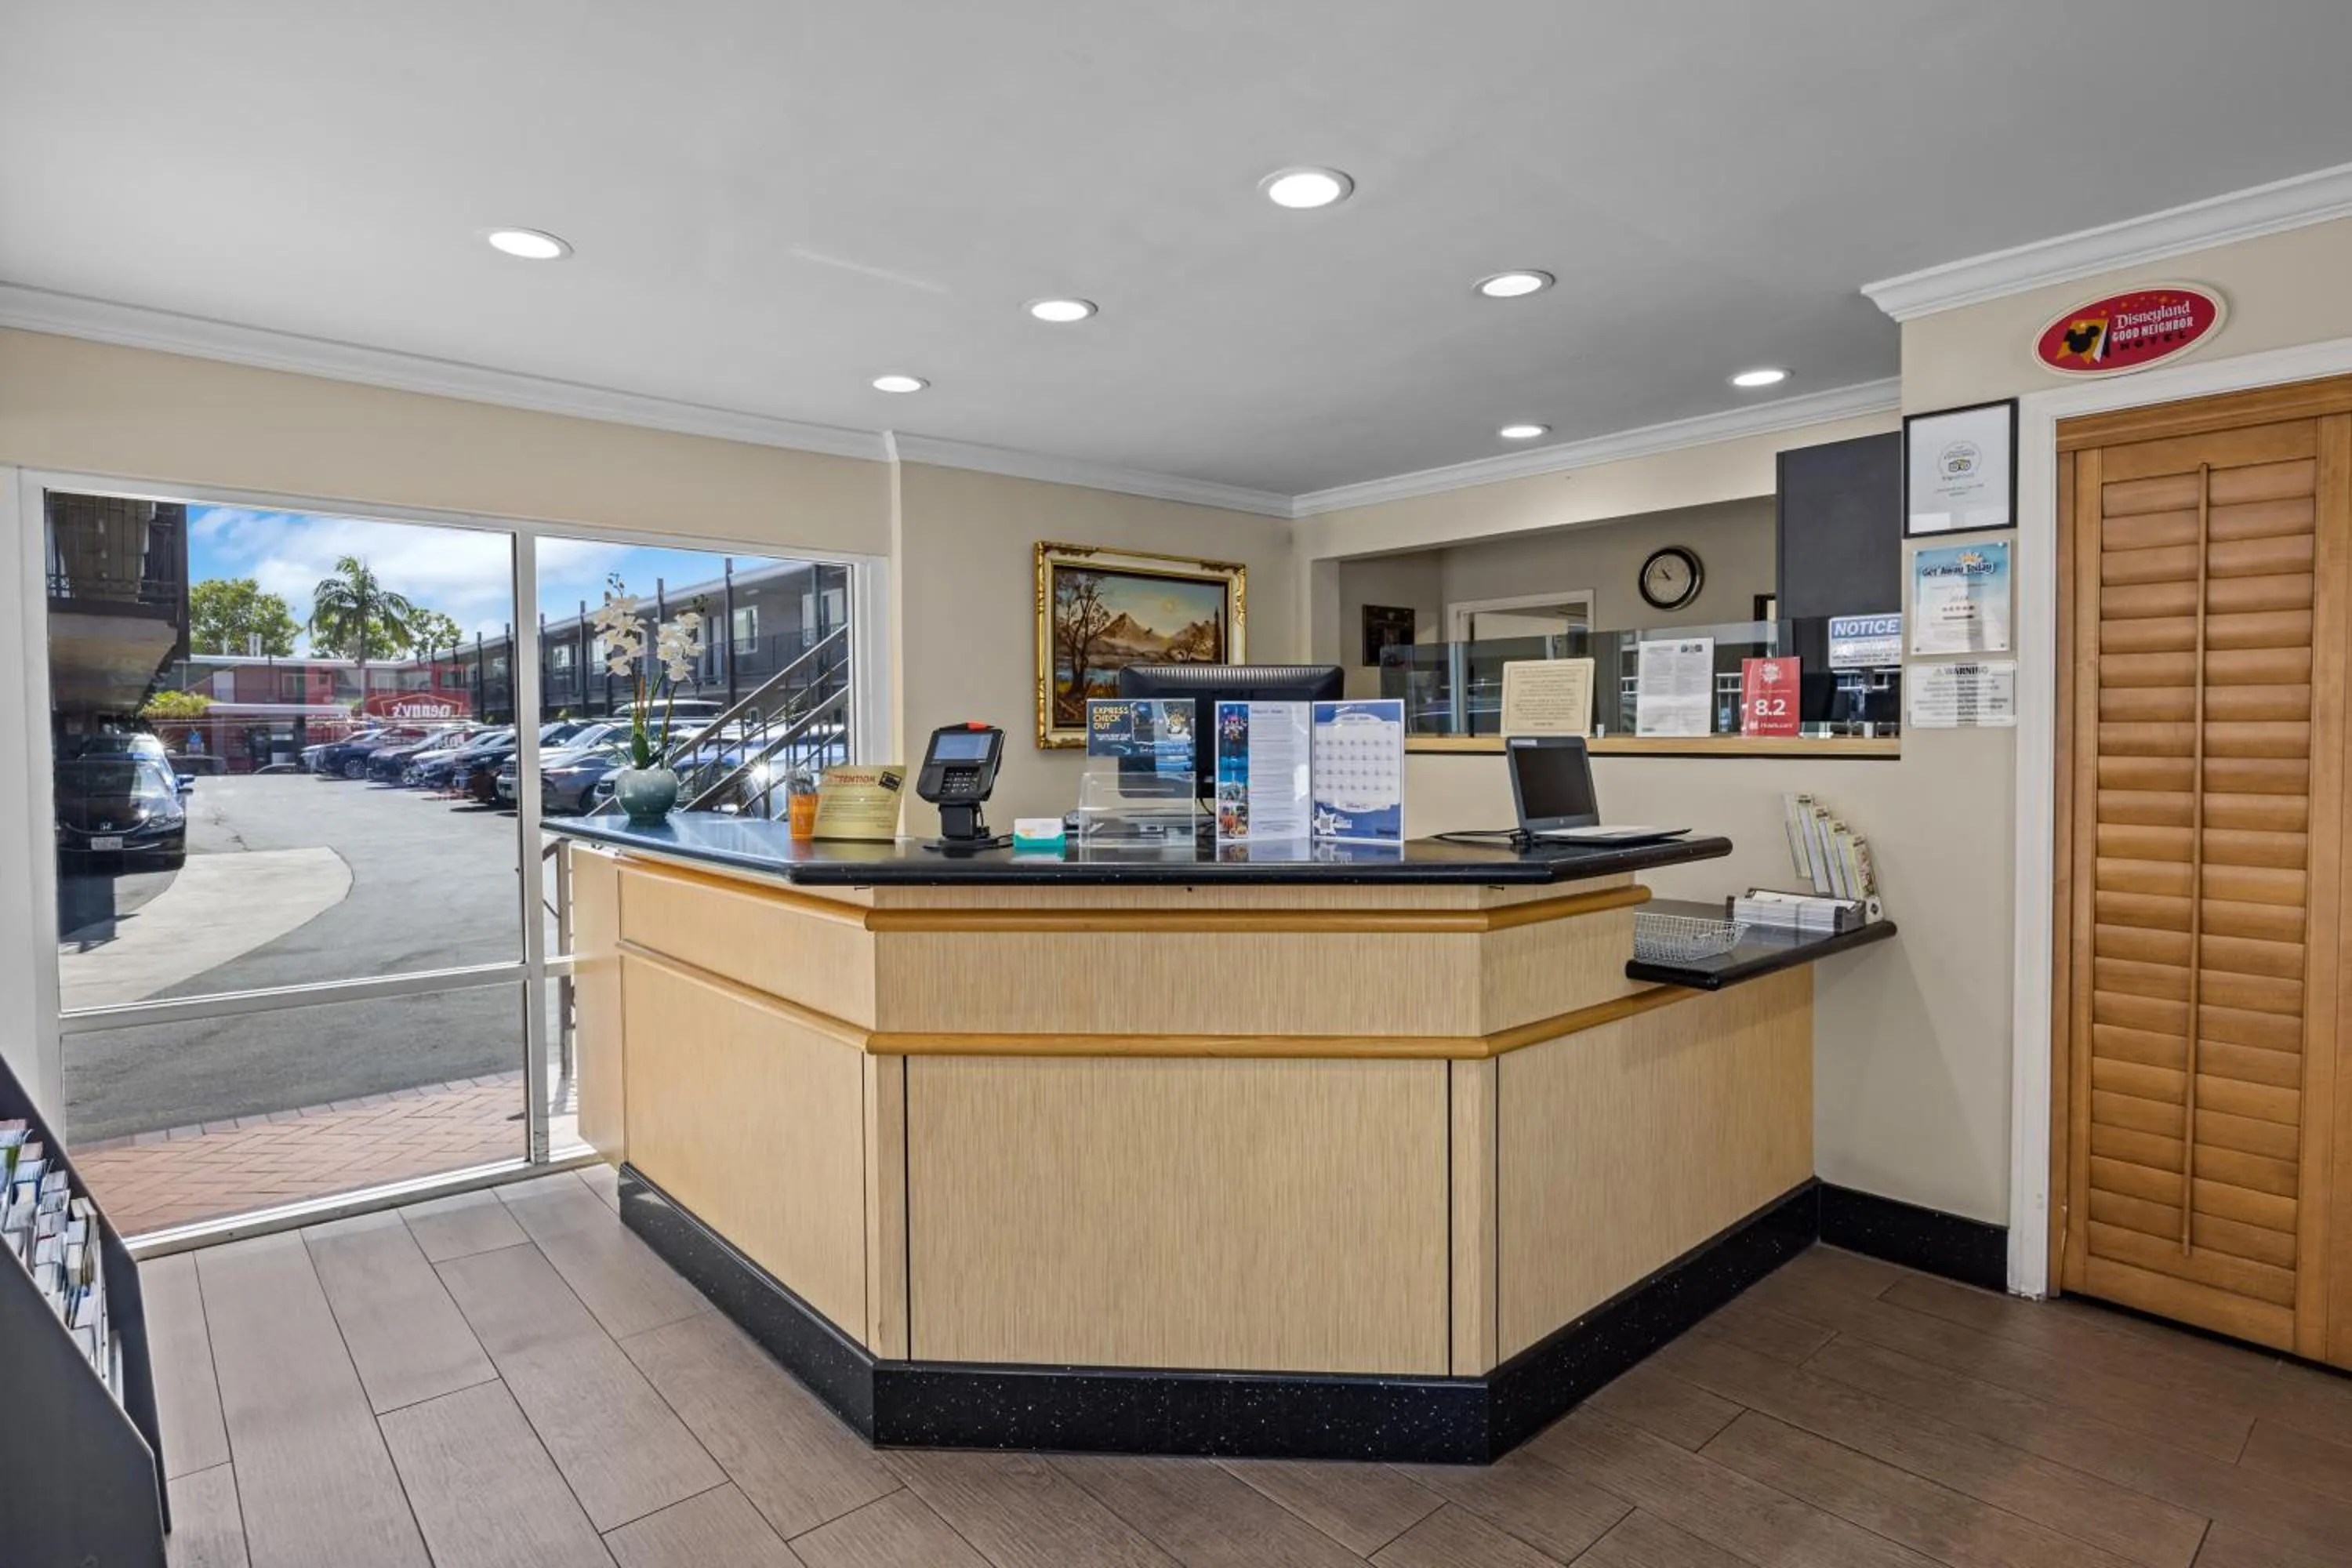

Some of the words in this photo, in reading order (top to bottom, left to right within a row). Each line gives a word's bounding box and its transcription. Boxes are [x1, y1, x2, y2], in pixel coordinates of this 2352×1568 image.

[2115, 300, 2190, 328] Disneyland
[2112, 328, 2140, 342] GOOD
[2141, 317, 2194, 336] NEIGHBOR
[2119, 332, 2187, 350] HOTEL
[1834, 619, 1900, 637] NOTICE
[1944, 666, 1989, 675] WARNING
[1755, 699, 1786, 716] 8.2
